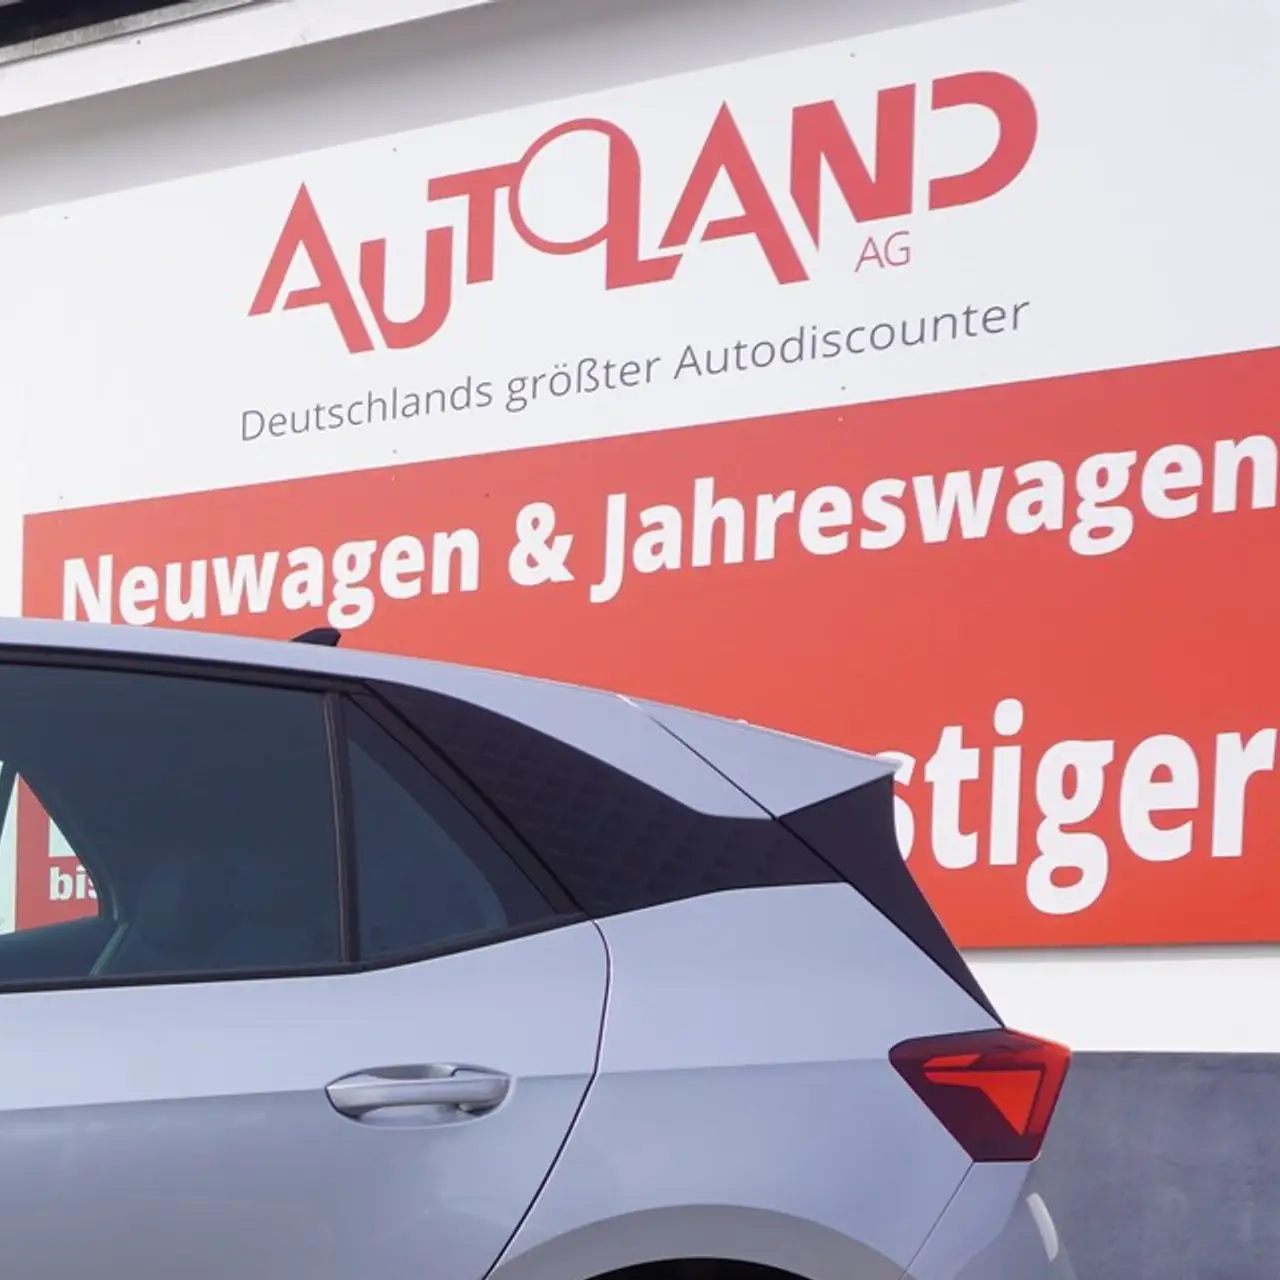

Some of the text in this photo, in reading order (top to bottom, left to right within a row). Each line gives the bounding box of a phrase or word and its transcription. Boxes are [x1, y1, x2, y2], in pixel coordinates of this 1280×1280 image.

[854, 230, 912, 273] AG
[241, 300, 1031, 442] Deutschlands größter Autodiscounter
[62, 433, 1279, 630] Neuwagen & Jahreswagen
